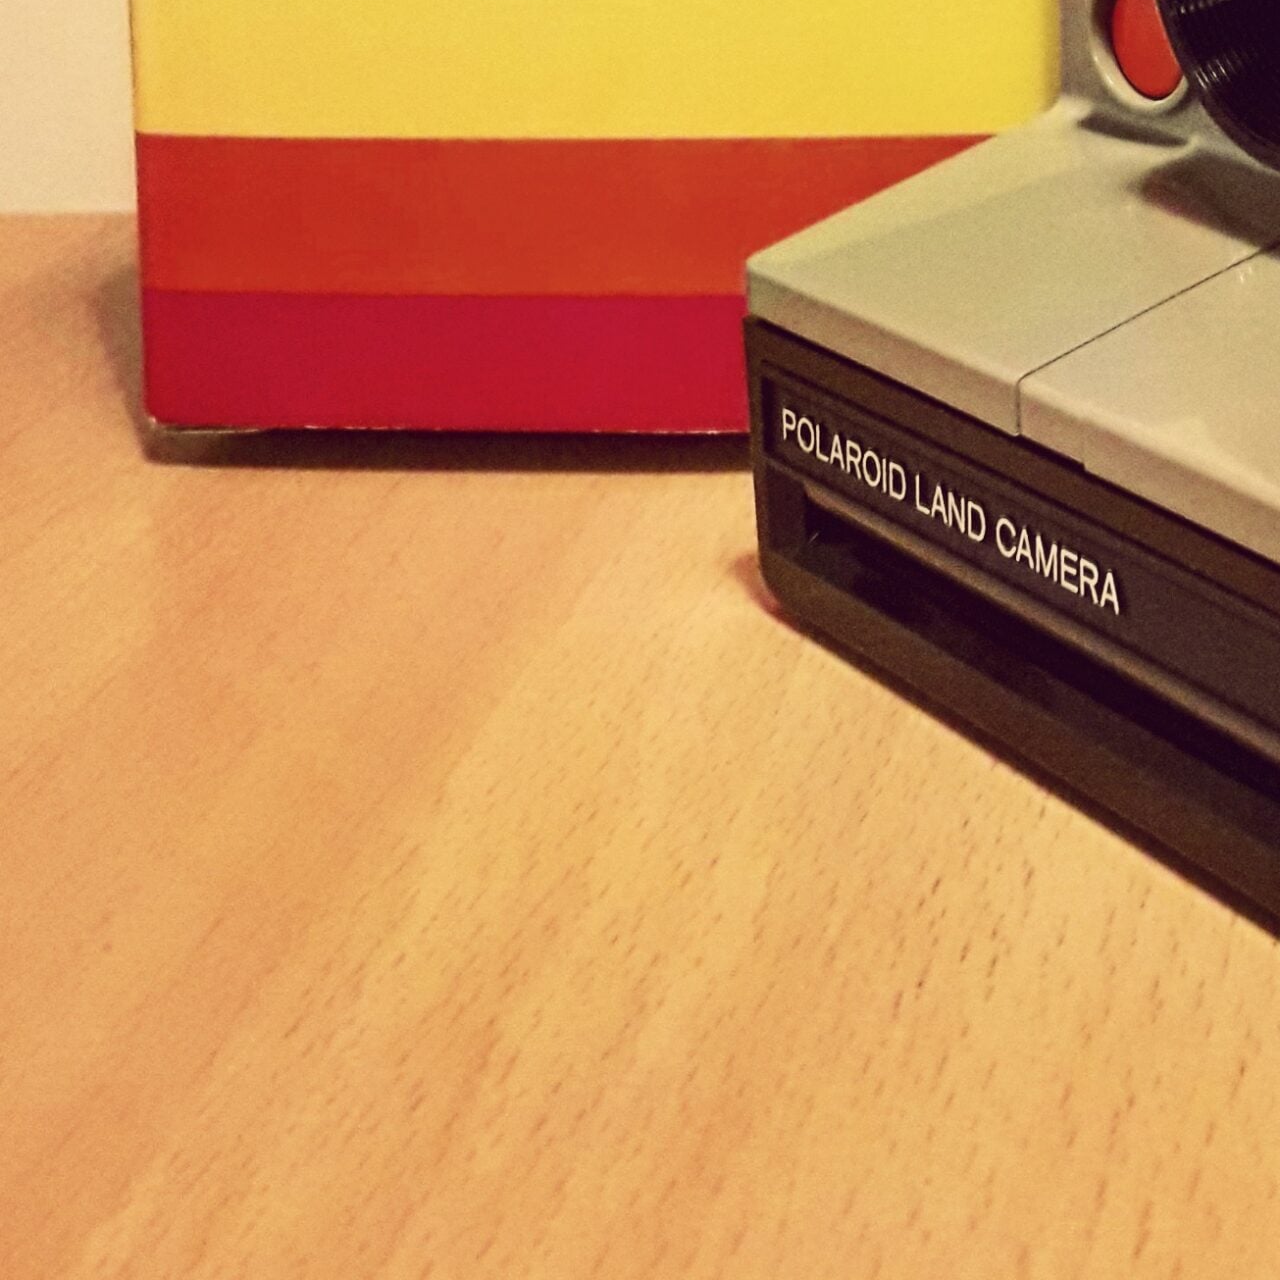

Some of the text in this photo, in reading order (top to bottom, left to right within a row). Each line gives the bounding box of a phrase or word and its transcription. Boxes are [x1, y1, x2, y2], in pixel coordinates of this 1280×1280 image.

[782, 407, 1120, 616] POLAROID LAND CAMERA
